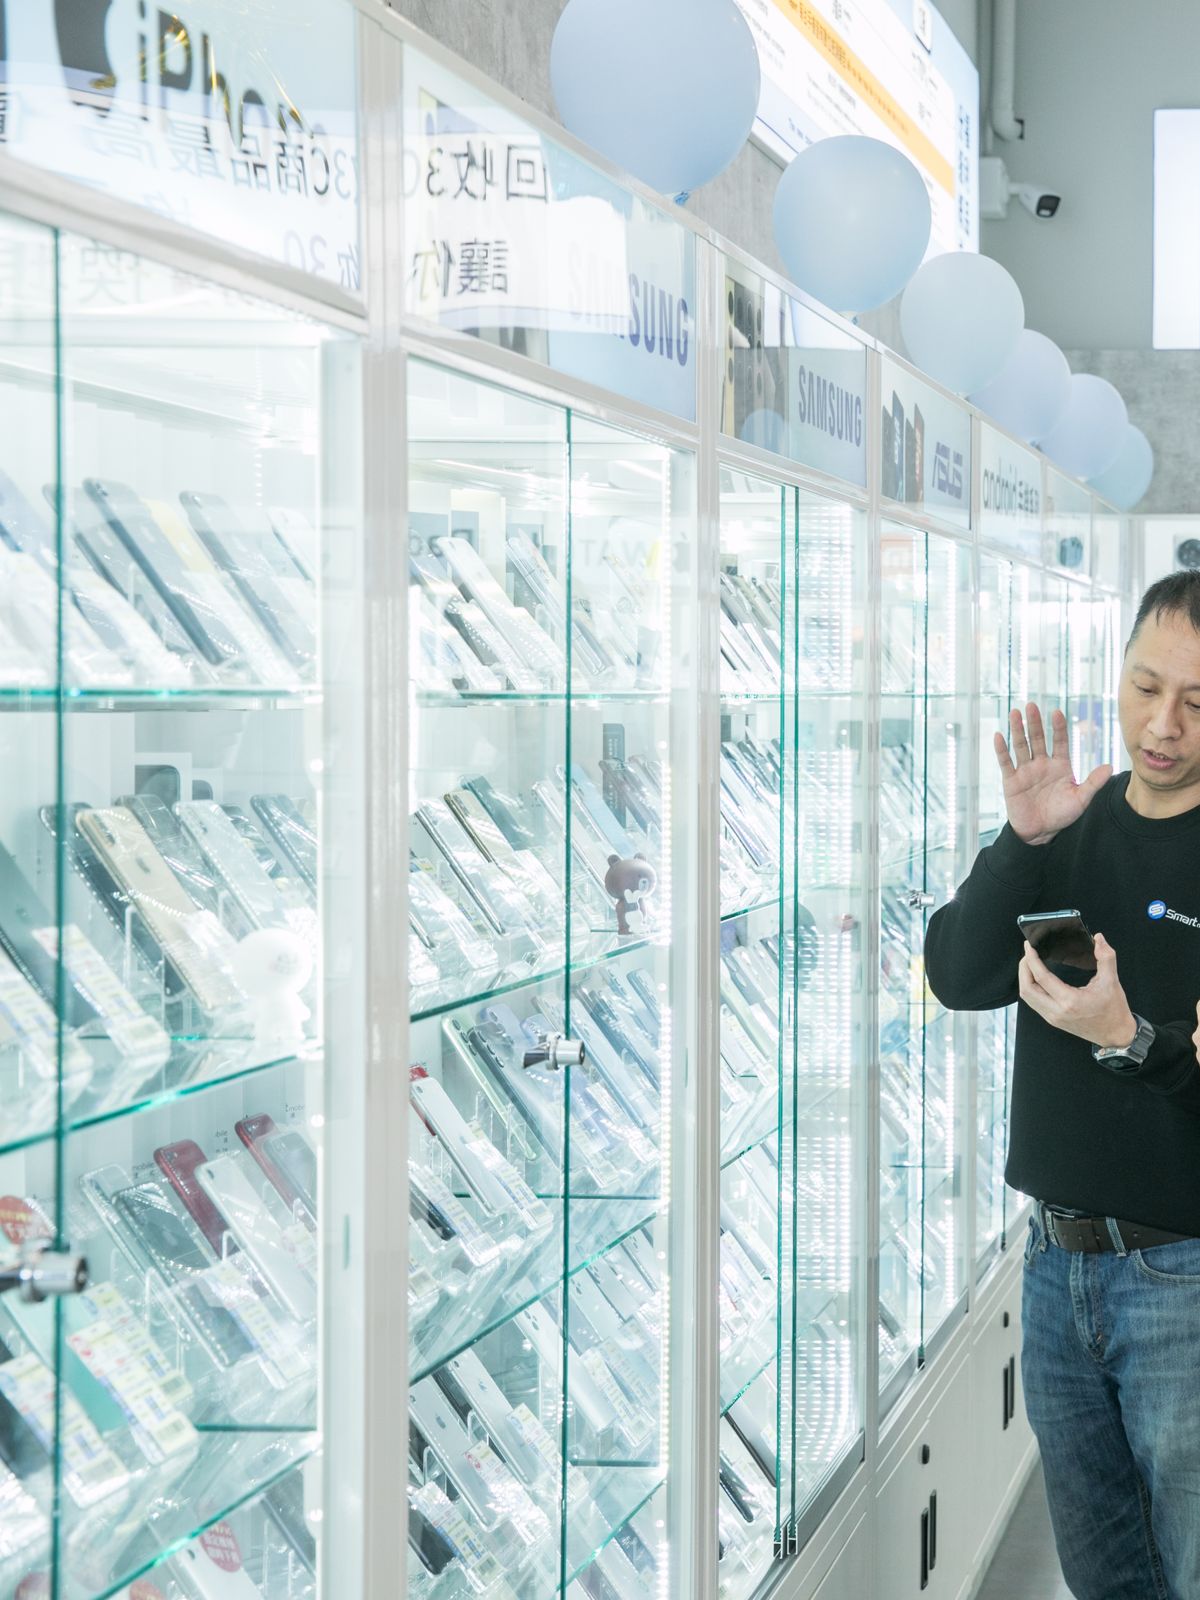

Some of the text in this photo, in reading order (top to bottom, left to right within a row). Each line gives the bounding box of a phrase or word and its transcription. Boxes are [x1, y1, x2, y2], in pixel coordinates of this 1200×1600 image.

[798, 364, 862, 448] SAMSUNG
[931, 441, 963, 500] ASUS
[1165, 908, 1199, 928] Smart
